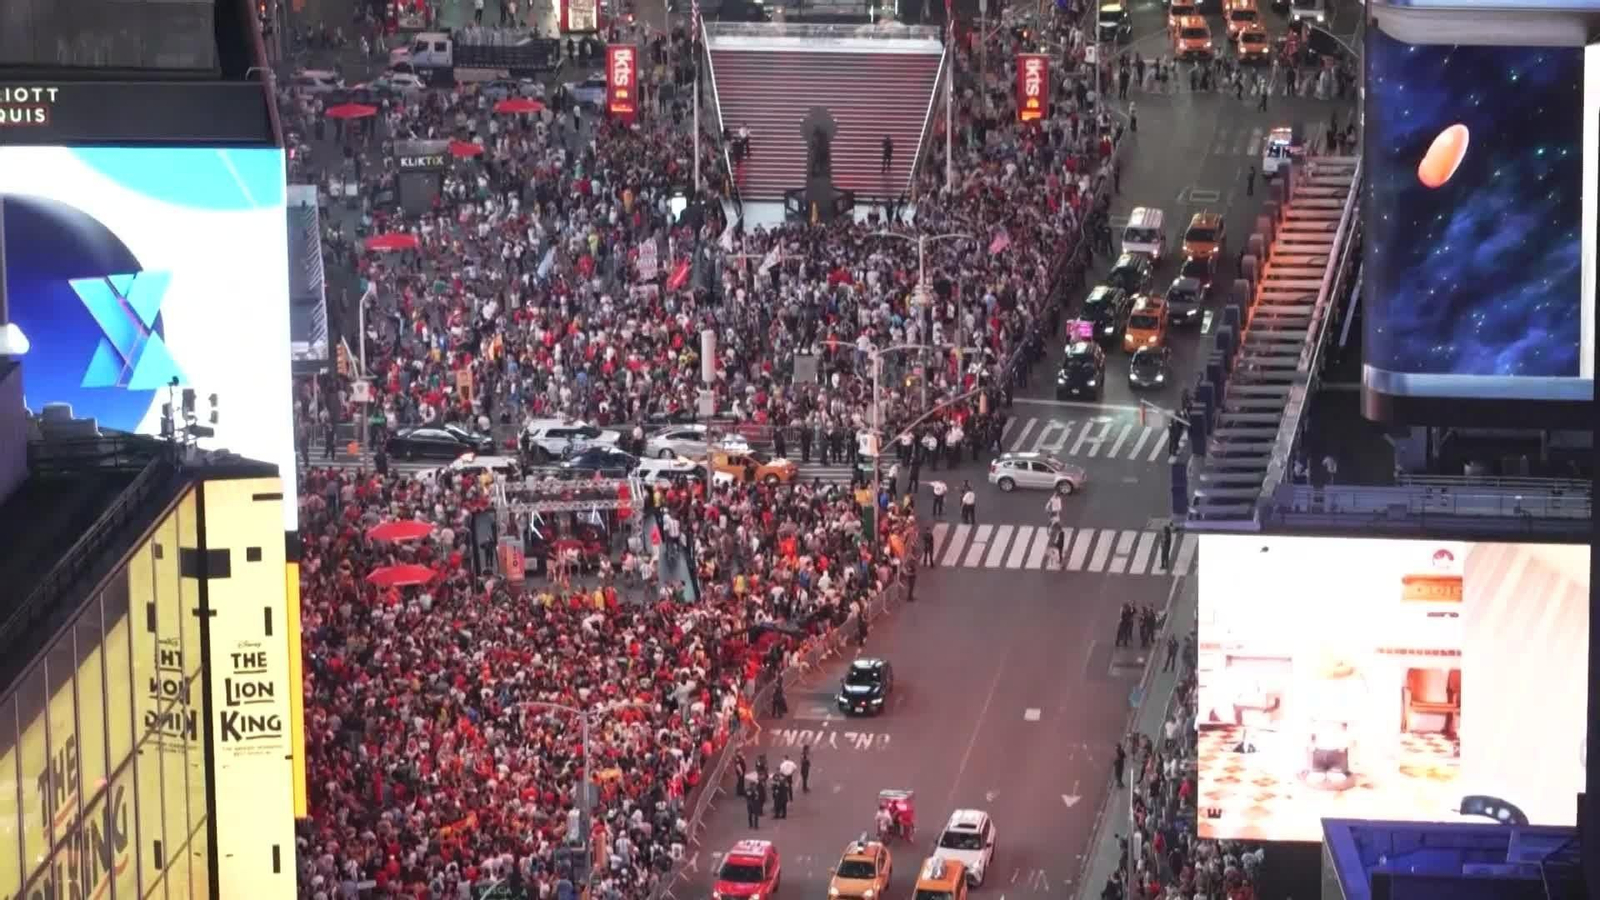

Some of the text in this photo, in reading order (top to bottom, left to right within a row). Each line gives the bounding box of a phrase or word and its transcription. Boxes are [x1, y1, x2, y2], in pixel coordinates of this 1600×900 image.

[0, 87, 59, 102] IOTT
[400, 156, 444, 167] KLIKTIX
[230, 651, 268, 669] THE
[225, 678, 275, 707] LION
[220, 710, 282, 742] KING
[37, 734, 78, 829] THE
